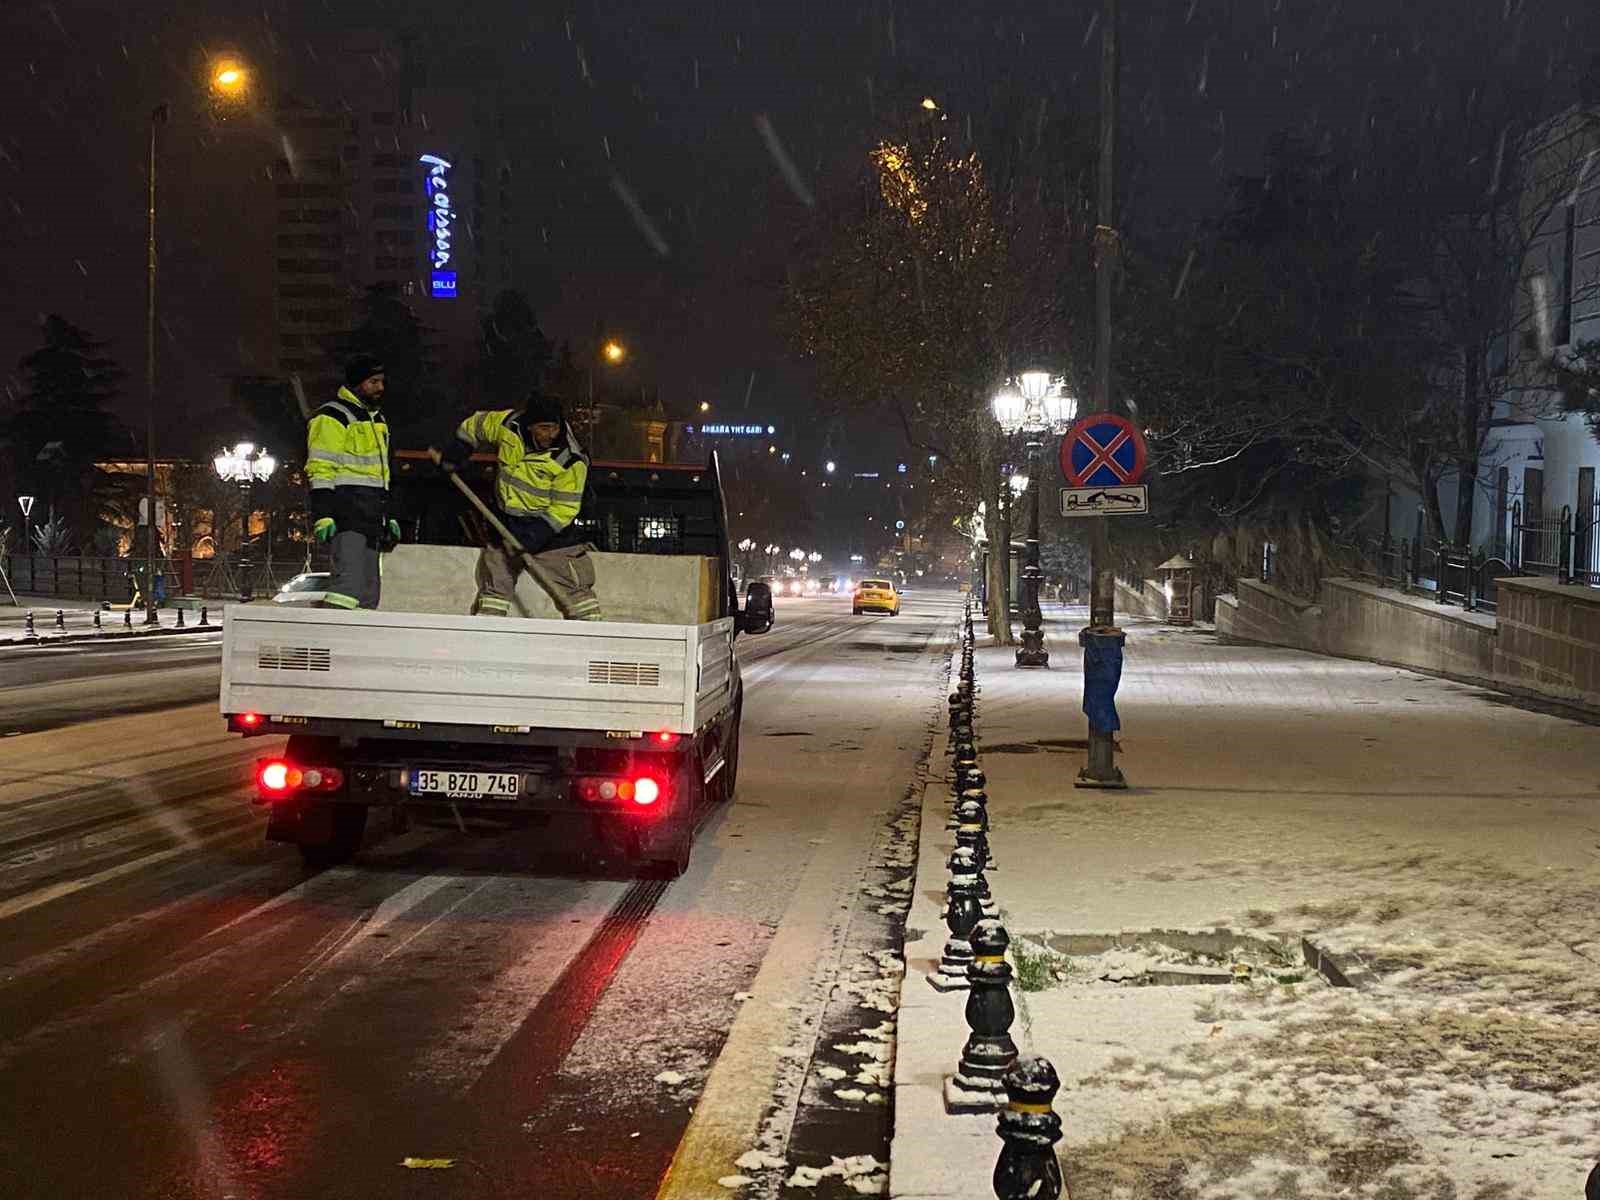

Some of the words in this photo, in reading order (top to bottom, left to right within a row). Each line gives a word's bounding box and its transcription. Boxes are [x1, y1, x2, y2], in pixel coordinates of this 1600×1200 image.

[432, 280, 456, 289] BLU
[420, 773, 439, 790] 35
[448, 774, 478, 791] BZD
[487, 775, 517, 793] 748
